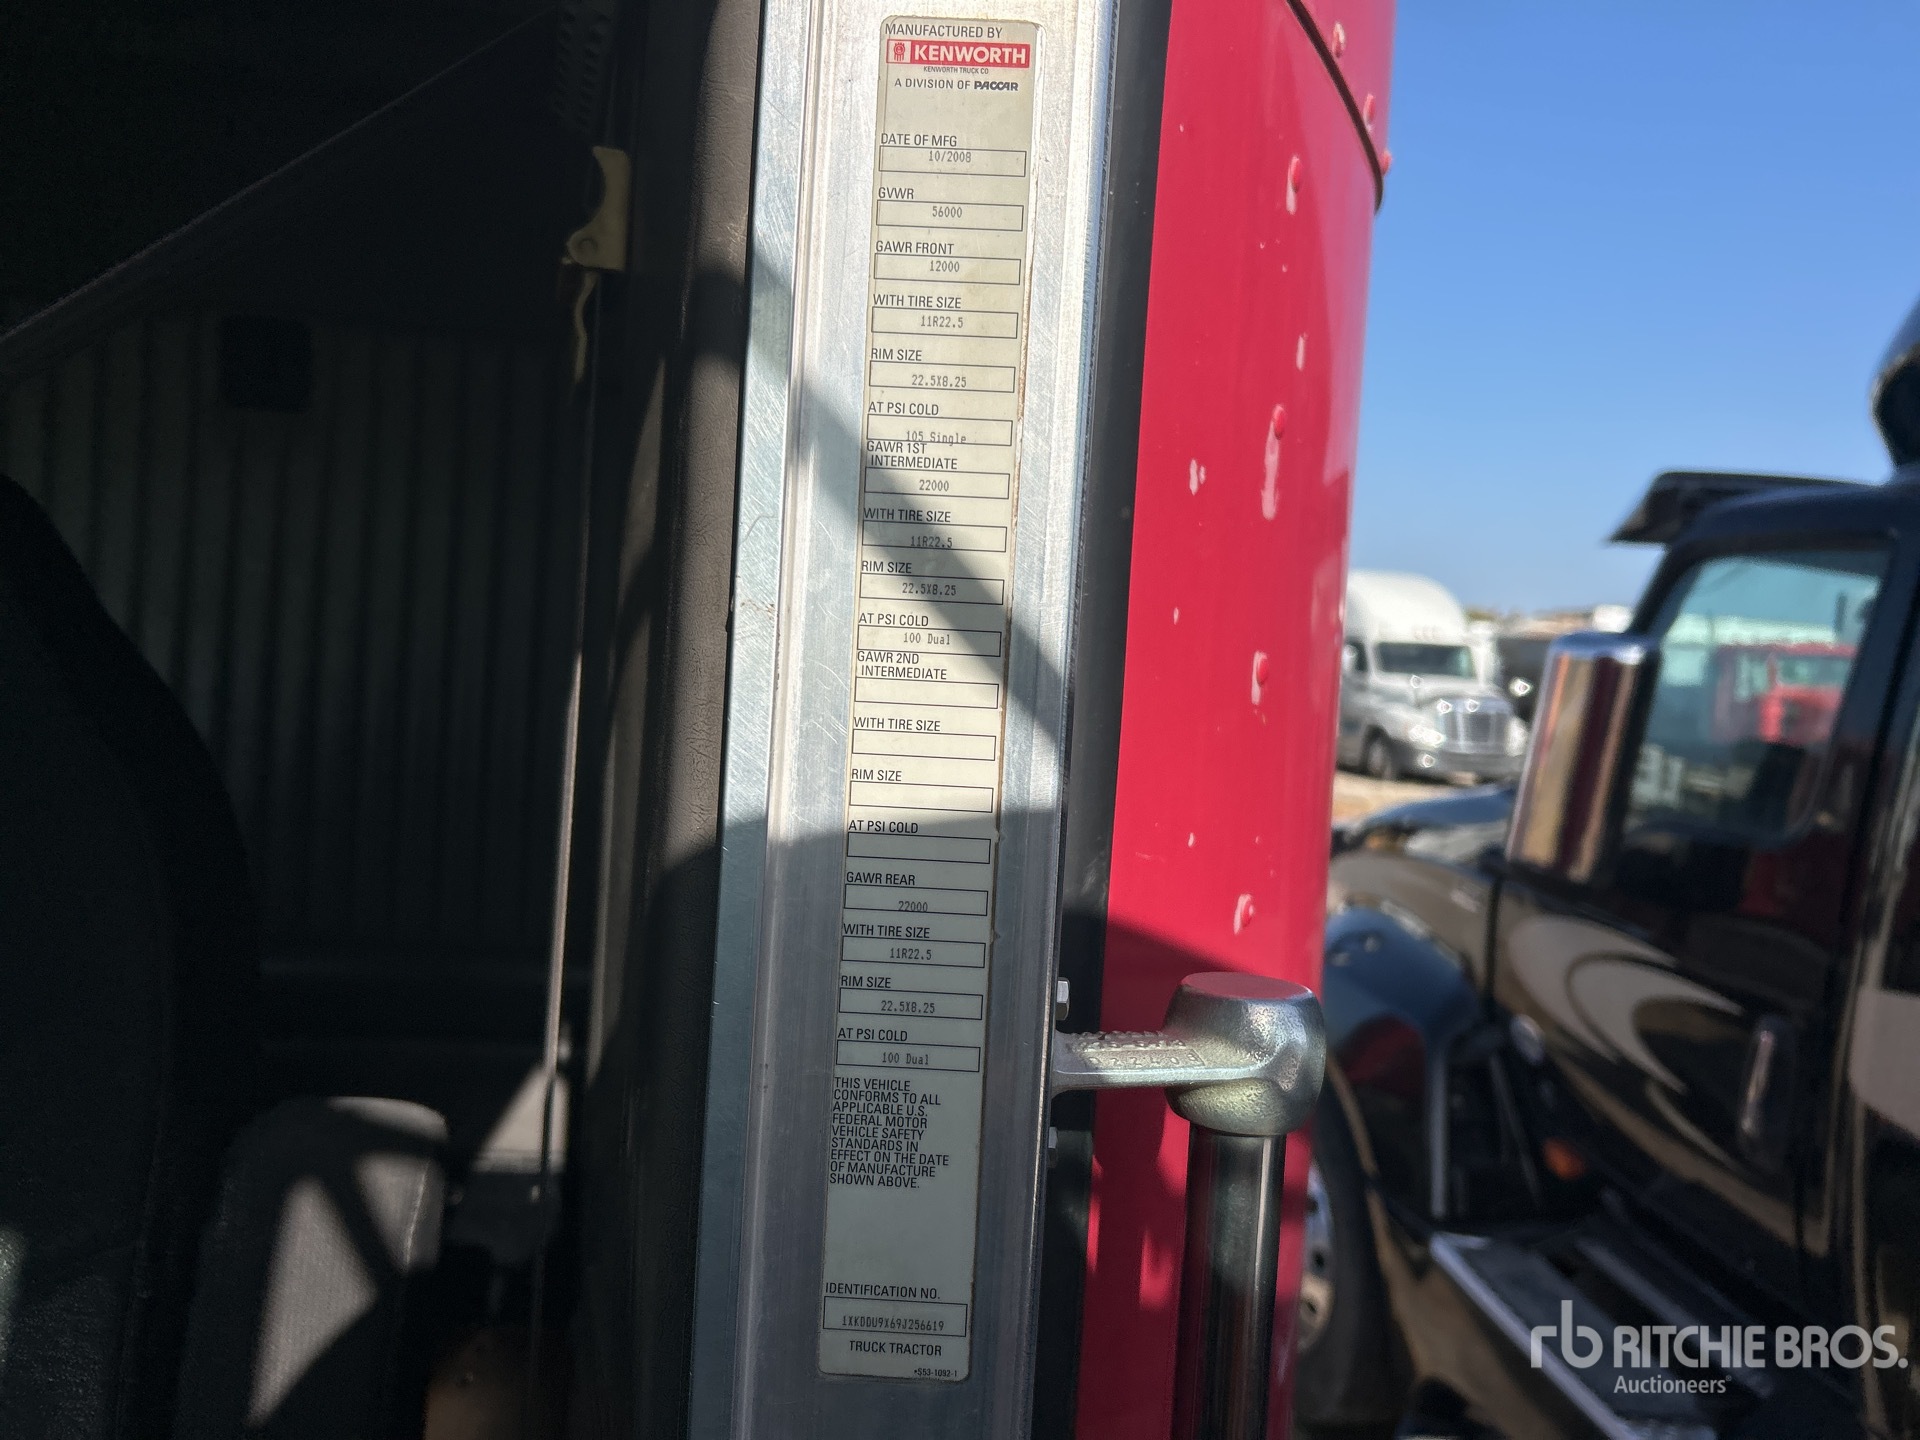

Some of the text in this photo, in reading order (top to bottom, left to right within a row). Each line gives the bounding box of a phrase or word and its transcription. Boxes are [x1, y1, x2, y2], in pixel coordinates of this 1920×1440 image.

[885, 24, 1002, 38] MANUFACTURED BY
[914, 45, 1026, 64] KENWORTH
[924, 66, 958, 74] KENWORTH
[895, 79, 1018, 91] A DIVISION OF PACCAR
[881, 133, 957, 147] DATE OF MFG
[929, 151, 972, 162] 10/2008
[878, 188, 914, 199] GVWR
[932, 206, 962, 218] 56000
[875, 241, 954, 255] GAWR FRONT
[930, 261, 959, 272] 12000
[873, 294, 961, 308] WITH TIRE SIZE
[921, 316, 963, 328] 11R22.5
[871, 348, 922, 361] RIM SIZE
[912, 375, 966, 388] 22.5X8.25
[868, 402, 939, 415] AT PSI COLD
[906, 431, 966, 446] 105 Single
[867, 441, 927, 454] GAWR 1ST
[871, 455, 957, 469] INTERMEDIATE
[919, 480, 949, 491] 22000
[863, 508, 951, 522] WITH TIRE SIZE
[911, 536, 952, 548] 11R22.5
[862, 561, 912, 573] RIM SIZE
[902, 583, 956, 595] 22.5X8.25
[859, 613, 929, 626] AT PSI COLD
[903, 633, 950, 645] 100 Dual
[857, 651, 919, 664] GAWR 2ND
[861, 665, 947, 680] INTERMEDIATE
[854, 717, 940, 731] WITH TIRE SIZE
[851, 769, 902, 781] RIM SIZE
[849, 820, 918, 833] AT PSI COLD
[846, 872, 915, 885] GAWR REAR
[898, 901, 928, 912] 22000
[843, 923, 930, 938] WITH TIRE SIZE
[890, 948, 931, 960] 11R22.5
[841, 976, 891, 988] RIM SIZE
[881, 1001, 935, 1013] 22.5X8.25
[838, 1028, 907, 1041] AT PSI COLD
[882, 1052, 929, 1065] 100 Dual
[835, 1077, 910, 1091] THIS VEHICLE
[834, 1089, 941, 1105] CONFORMS TO ALL
[833, 1102, 928, 1117] APPLICABLE U.S.
[832, 1113, 927, 1129] FEDERAL MOTOR
[832, 1125, 924, 1140] VEHICLE SAFETY
[831, 1138, 919, 1152] STANDARDS IN
[831, 1149, 949, 1166] EFFECT ON THE DATE
[830, 1161, 936, 1177] OF MANUFACTURE
[830, 1173, 920, 1188] SHOWN ABOVE.
[826, 1283, 940, 1299] IDENTIFICATION NO.
[850, 1341, 942, 1356] TRUCK TRACTOR
